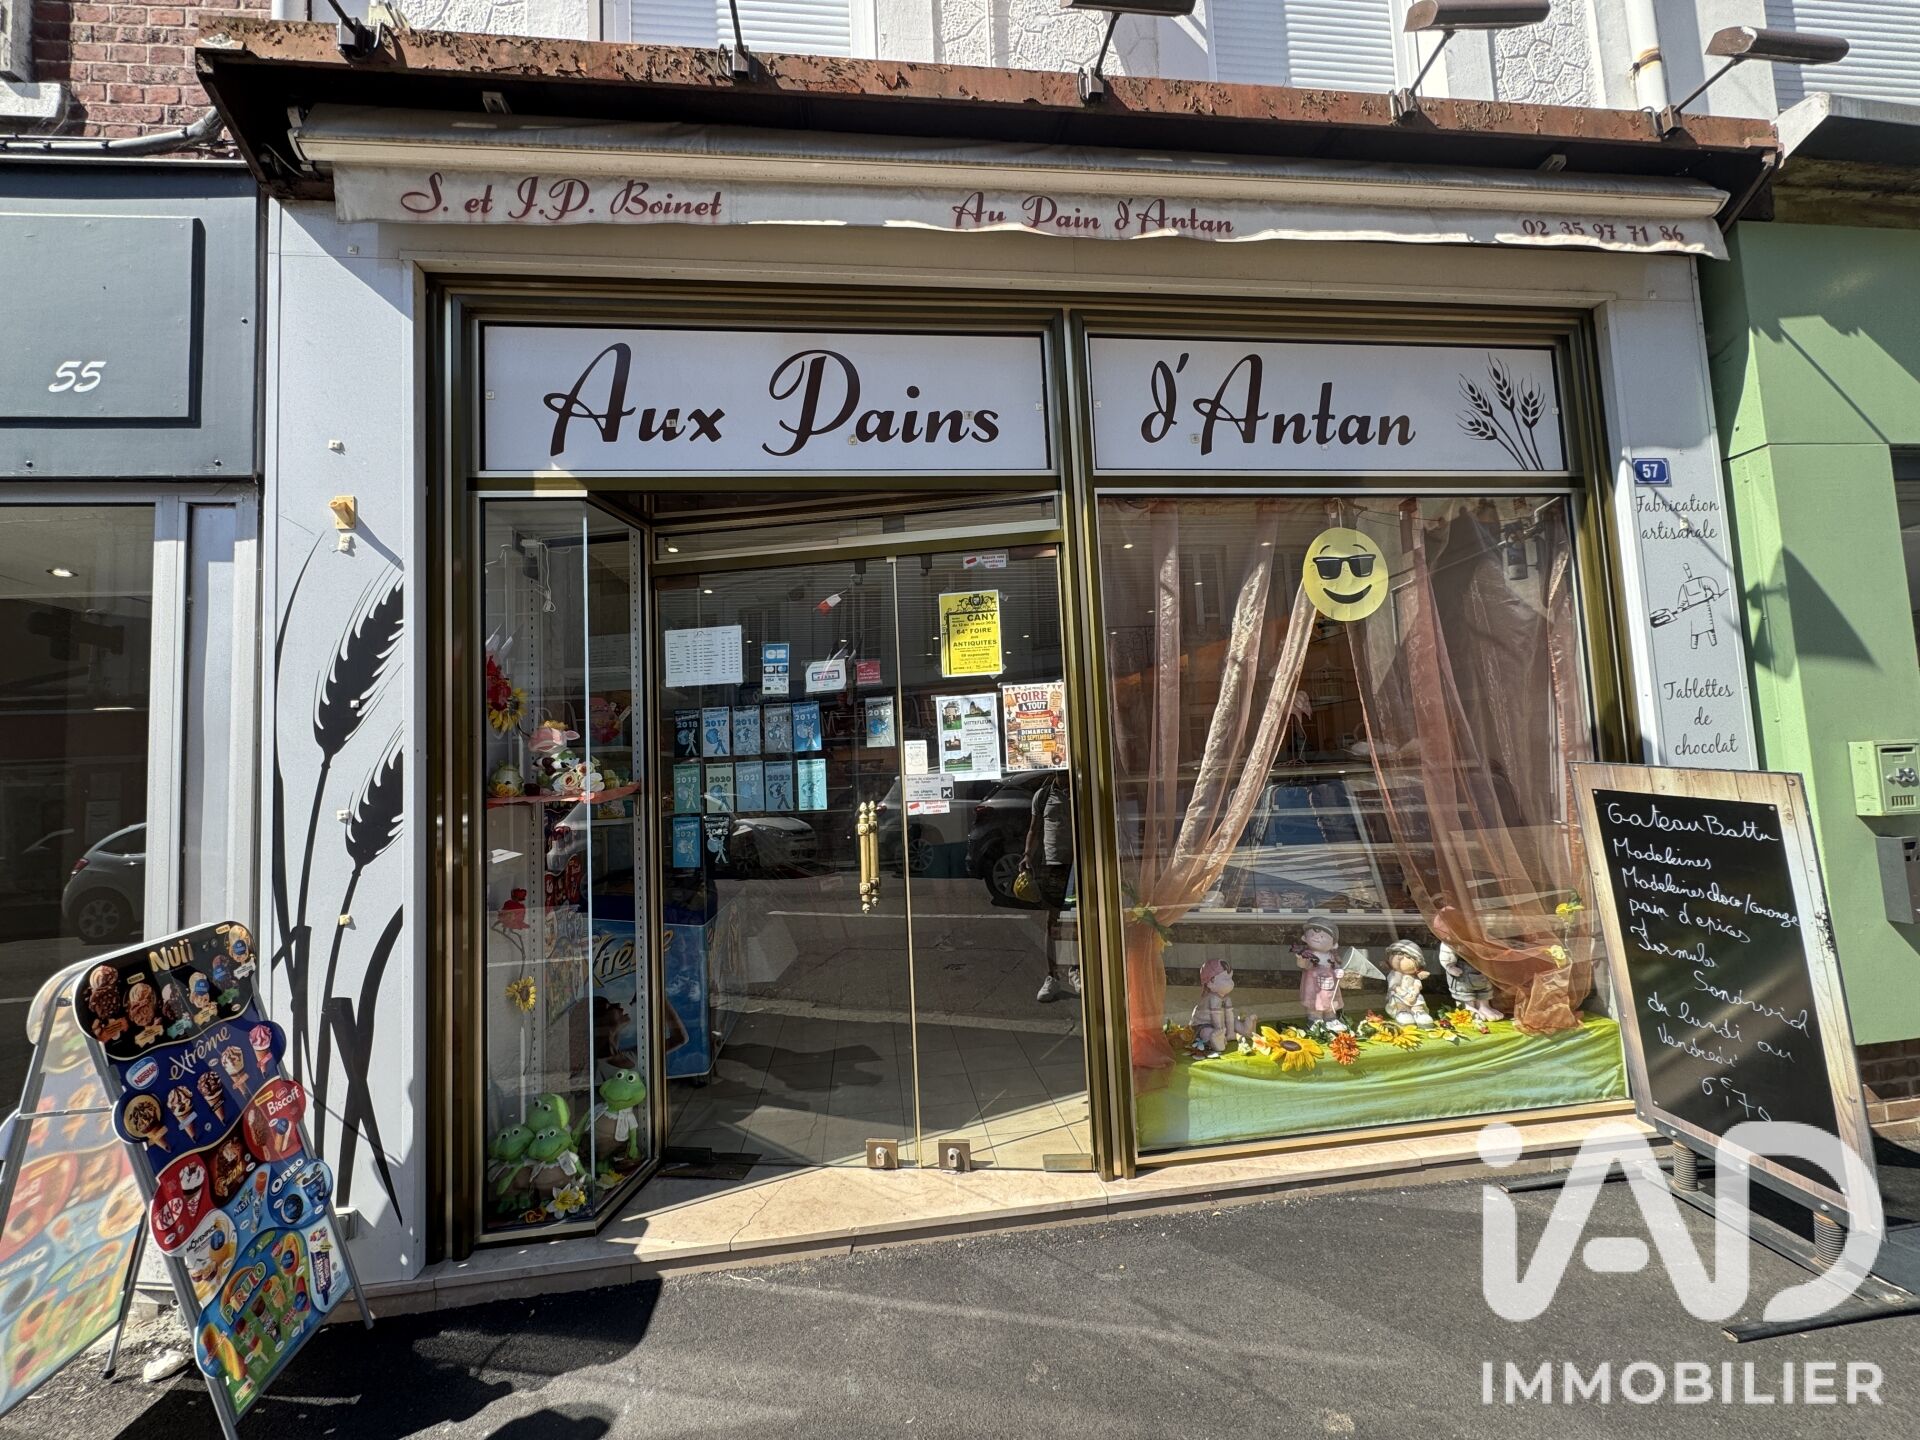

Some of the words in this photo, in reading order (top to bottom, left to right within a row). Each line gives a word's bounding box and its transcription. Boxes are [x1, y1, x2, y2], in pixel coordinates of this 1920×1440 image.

[401, 172, 448, 213] S.
[465, 185, 493, 214] et
[610, 179, 722, 216] Boinet
[952, 192, 1006, 227] Au
[1021, 195, 1102, 229] Pain
[1114, 198, 1234, 235] d'Antan
[1522, 219, 1550, 235] 02
[1560, 221, 1585, 235] 35
[1592, 223, 1617, 240] 97
[1626, 225, 1649, 242] 71
[1659, 225, 1684, 241] 86
[48, 361, 107, 392] 55
[543, 342, 725, 457] Aux
[762, 349, 1000, 457] Pains
[1140, 352, 1416, 456] d'Antan
[1642, 463, 1658, 479] 57
[1636, 492, 1720, 513] Fabrication
[1641, 519, 1717, 540] artisanale
[967, 613, 996, 622] CANY
[1014, 690, 1048, 702] FOIRE
[1663, 677, 1735, 700] Tablettes
[705, 719, 727, 728] 2017
[795, 713, 817, 721] 2014
[868, 709, 891, 717] 2013
[1694, 706, 1713, 725] de
[677, 720, 698, 729] 2018
[1021, 728, 1052, 736] DIMANCHE
[1675, 732, 1739, 756] chocolat
[709, 775, 732, 783] 2020
[267, 1085, 301, 1116] Biscoff
[271, 1159, 304, 1193] OREO
[221, 1261, 267, 1326] PIRULO
